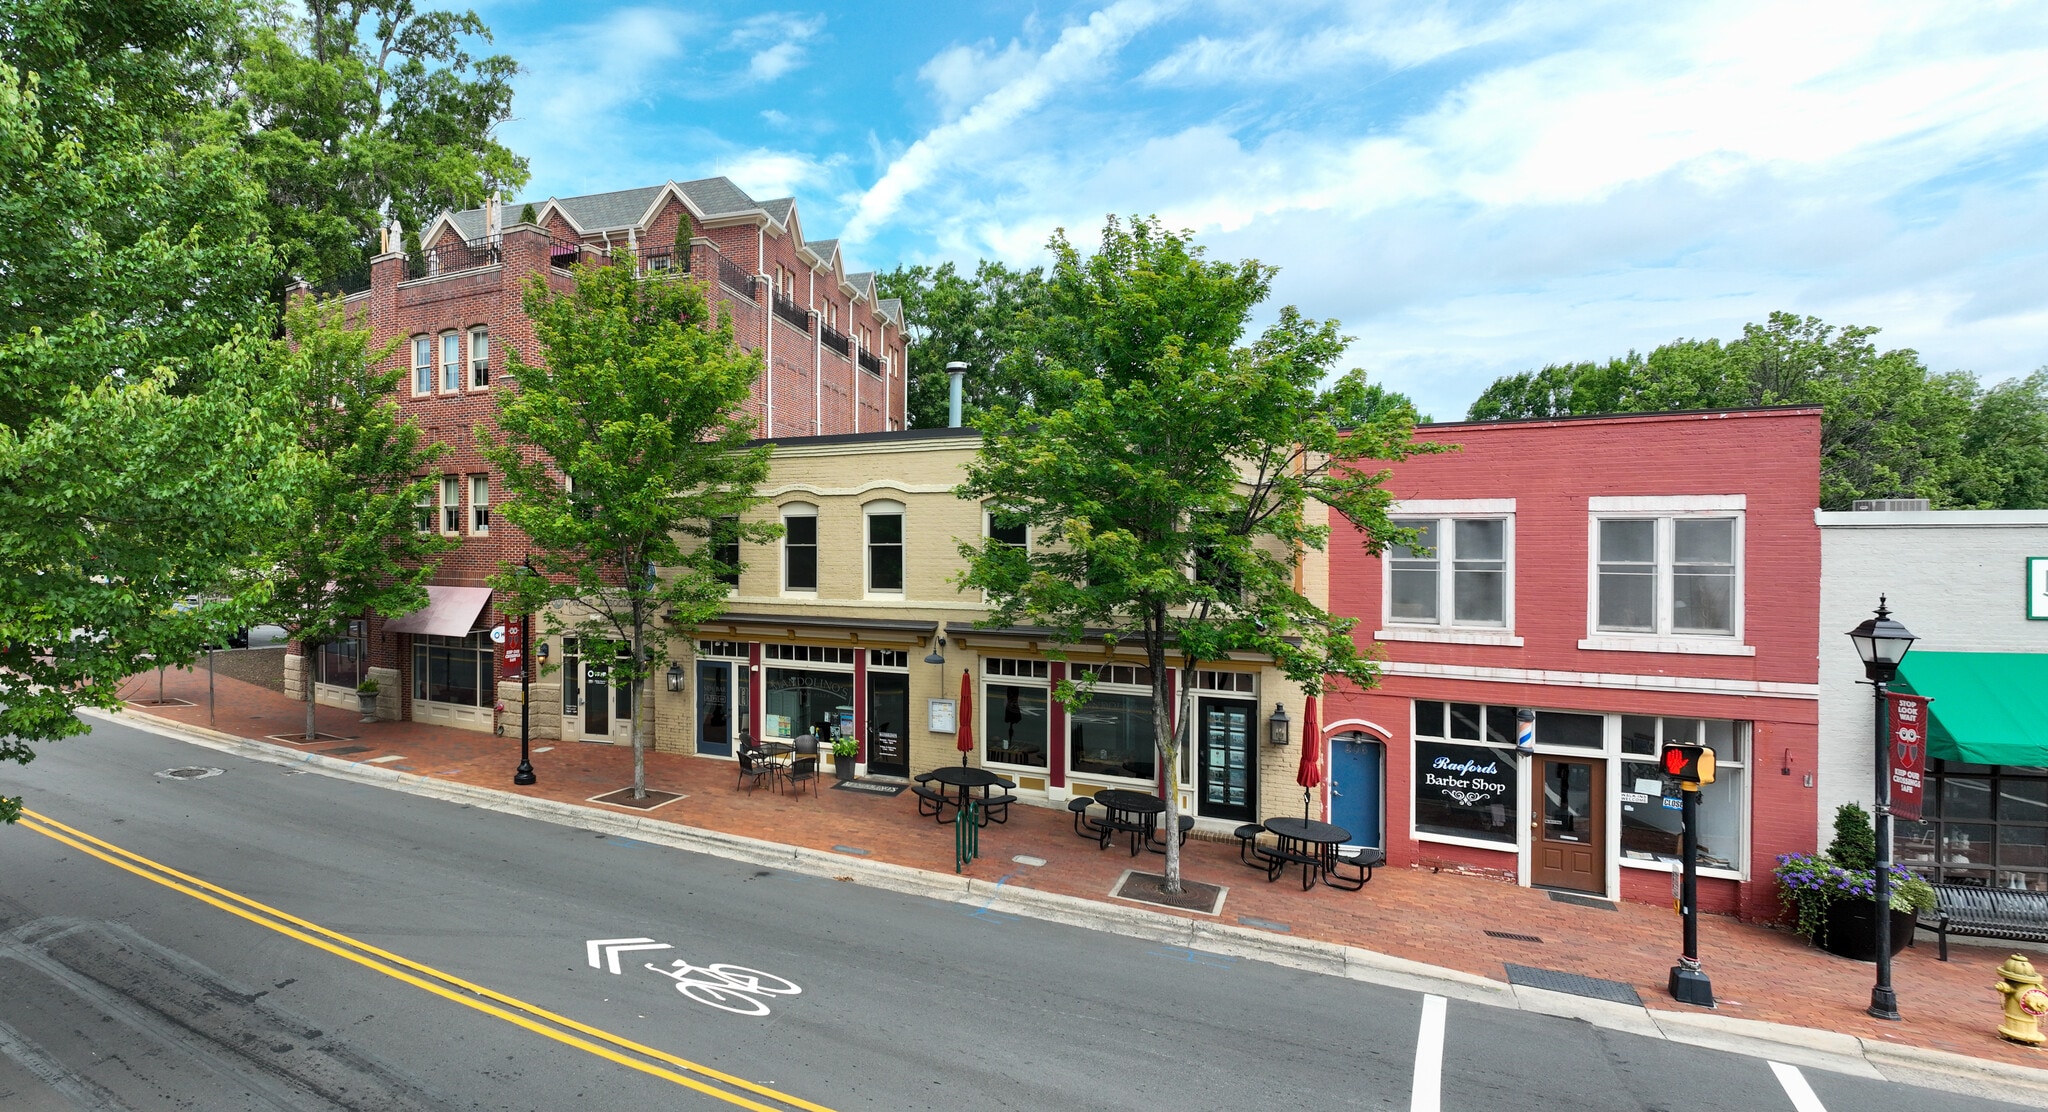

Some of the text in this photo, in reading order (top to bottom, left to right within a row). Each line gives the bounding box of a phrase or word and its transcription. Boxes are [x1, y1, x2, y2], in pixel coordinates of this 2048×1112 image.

[768, 676, 848, 697] MANDOLINO'S
[1899, 700, 1917, 708] STOP
[1898, 706, 1918, 715] LOOK
[1899, 713, 1916, 721] WAIT
[1432, 756, 1497, 776] Raefords
[1907, 771, 1920, 780] OUR
[1425, 773, 1506, 795] Barber Shop
